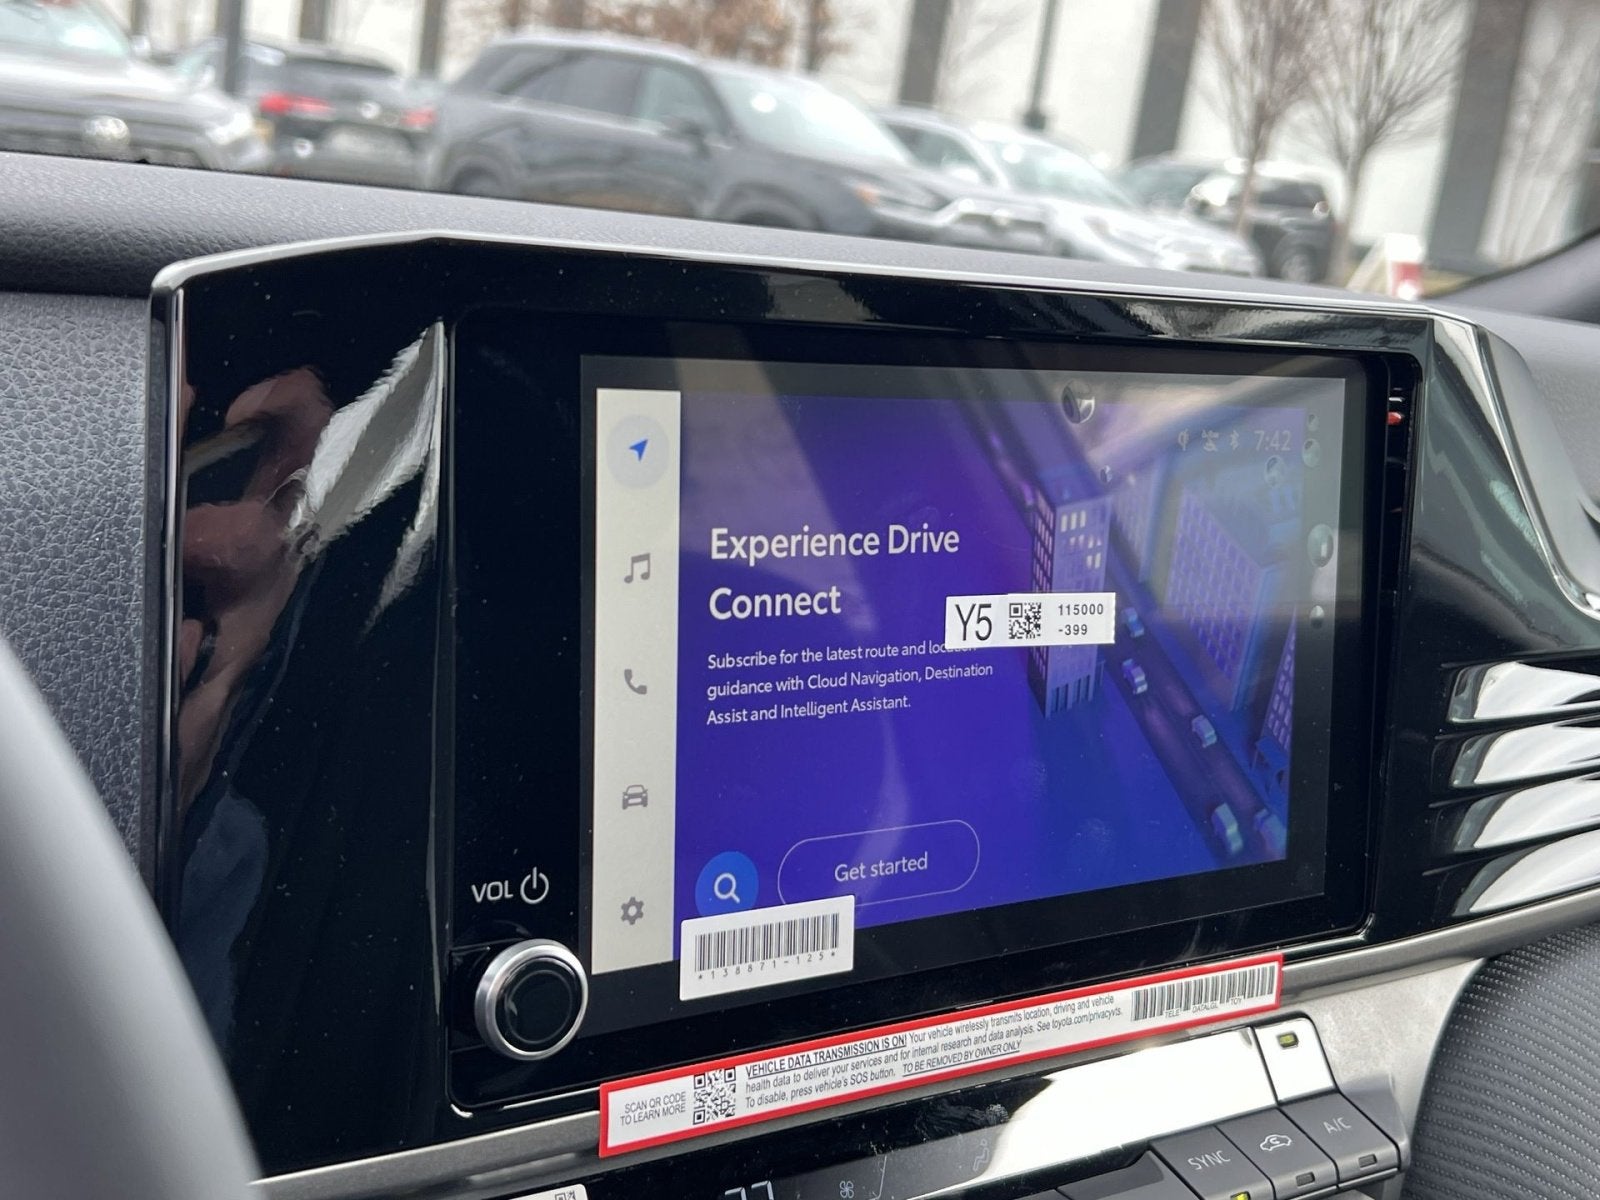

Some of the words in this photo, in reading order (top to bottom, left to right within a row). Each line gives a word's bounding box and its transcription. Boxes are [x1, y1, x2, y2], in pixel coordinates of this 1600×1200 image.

[1254, 430, 1292, 451] 7:42
[711, 525, 880, 567] Experience
[888, 523, 960, 554] Drive
[709, 586, 841, 620] Connect
[1057, 603, 1104, 616] 115000
[955, 603, 992, 641] Y5
[1058, 624, 1088, 636] -399
[708, 650, 777, 669] Subscribe
[779, 649, 798, 665] for
[801, 648, 823, 662] the
[826, 645, 863, 661] latest
[865, 644, 899, 658] route
[901, 640, 926, 656] and
[707, 681, 773, 700] guidance
[776, 675, 804, 692] with
[807, 672, 847, 690] Cloud
[850, 668, 922, 688] Navigation,
[925, 663, 993, 680] Destination
[706, 708, 748, 725] Assist
[751, 705, 778, 721] and
[781, 700, 848, 718] Intelligent
[850, 695, 911, 713] Assistant.
[834, 863, 867, 882] Get
[870, 851, 928, 878] started
[471, 880, 513, 903] VOL
[1165, 1008, 1181, 1019] TELE
[745, 1058, 785, 1077] VEHICLE
[788, 1054, 811, 1068] DATA
[813, 1040, 880, 1064] TRANSMISSION
[882, 1036, 891, 1048] IS
[892, 1034, 907, 1047] ON!
[909, 1032, 926, 1044] Your
[928, 1025, 953, 1040] vehicle
[955, 1020, 989, 1035] wirelessly
[991, 1013, 1022, 1028] transmits
[1023, 1006, 1052, 1020] location,
[1053, 1001, 1076, 1014] driving
[1077, 998, 1090, 1010] and
[1091, 993, 1114, 1007] vehicle
[745, 1079, 770, 1094] health
[773, 1074, 790, 1087] data
[793, 1073, 801, 1084] to
[803, 1066, 830, 1081] deliver
[832, 1063, 849, 1078] your
[851, 1055, 882, 1071] services
[884, 1051, 898, 1064] and
[900, 1048, 911, 1061] for
[912, 1043, 939, 1057] internal
[941, 1037, 972, 1051] research
[973, 1032, 987, 1045] and
[988, 1027, 1004, 1042] data
[1005, 1021, 1035, 1038] analysis.
[1037, 1019, 1051, 1032] See
[745, 1096, 755, 1108] To
[757, 1088, 788, 1106] disable,
[790, 1084, 813, 1100] press
[814, 1074, 848, 1093] vehicle's
[850, 1073, 868, 1086] SOS
[870, 1067, 896, 1081] button.
[902, 1062, 914, 1074] TO
[914, 1059, 925, 1071] BE
[925, 1051, 963, 1069] REMOVED
[963, 1049, 975, 1061] BY
[975, 1043, 1002, 1058] OWNER
[1002, 1040, 1022, 1052] ONLY
[620, 1114, 632, 1126] TO
[633, 1108, 660, 1123] LEARN
[662, 1102, 686, 1117] MORE
[624, 1100, 648, 1114] SCAN
[649, 1097, 662, 1109] QR
[663, 1091, 687, 1106] CODE
[1322, 1117, 1352, 1135] A/C
[1188, 1150, 1232, 1171] SYNC
